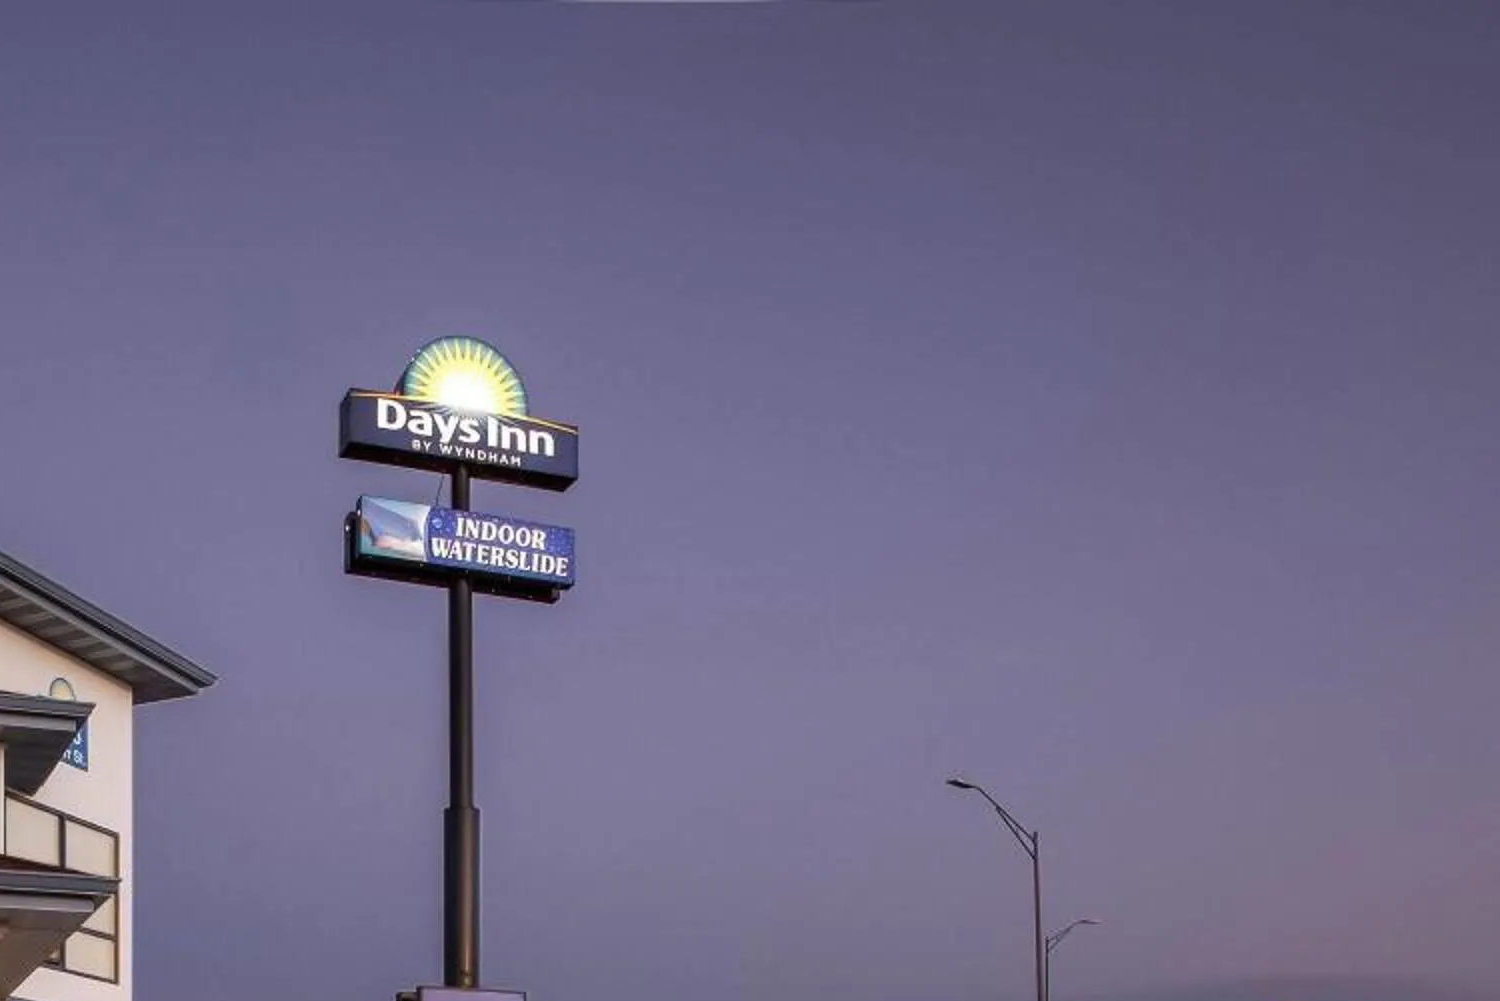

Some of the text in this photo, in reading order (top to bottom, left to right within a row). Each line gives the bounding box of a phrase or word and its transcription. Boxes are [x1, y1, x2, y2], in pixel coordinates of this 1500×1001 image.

[377, 398, 555, 457] Days Inn
[411, 439, 521, 467] BY WYNDHAM
[456, 517, 547, 550] INDOOR
[431, 537, 569, 577] WATERSLIDE
